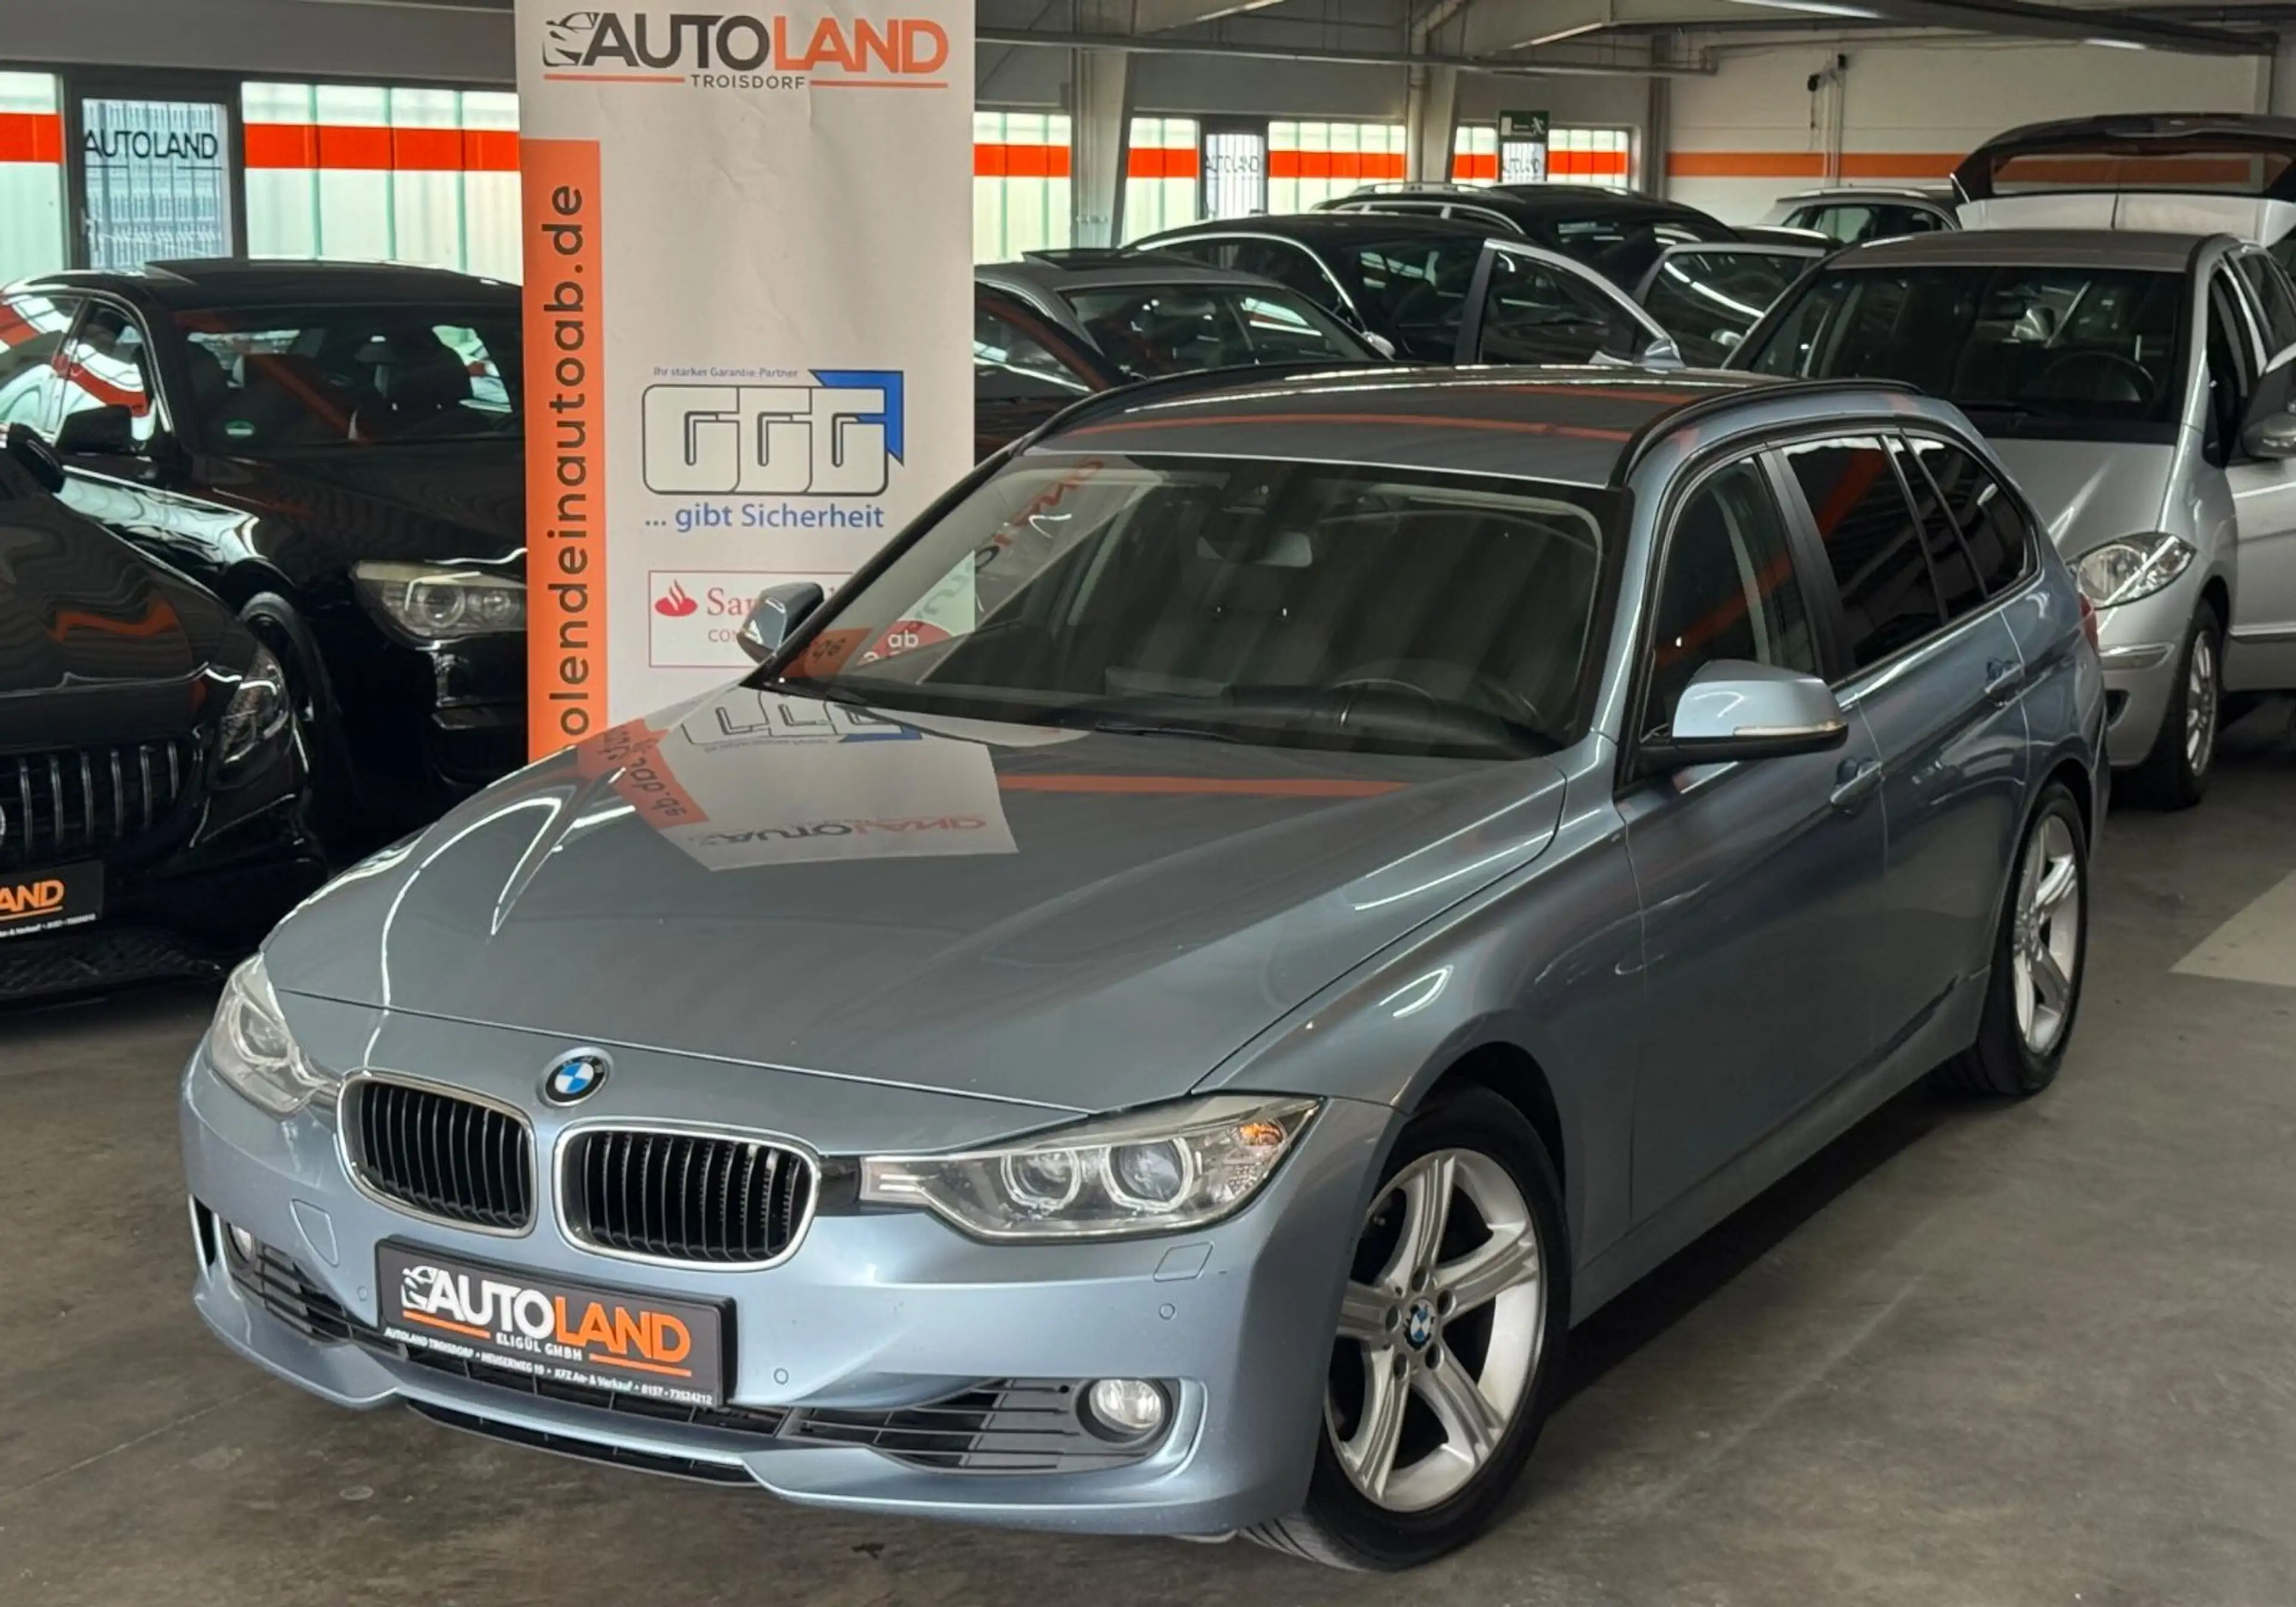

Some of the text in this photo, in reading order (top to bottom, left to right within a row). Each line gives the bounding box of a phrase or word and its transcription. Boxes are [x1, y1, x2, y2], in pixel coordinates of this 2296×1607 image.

[581, 12, 949, 75] AUTOLAND
[691, 74, 805, 89] TROISDORF
[84, 129, 218, 159] AUTOLAND
[675, 503, 732, 533] gibt
[741, 503, 885, 528] Sicherheit
[887, 630, 919, 648] ab
[426, 1269, 692, 1362] AUTOLAND
[496, 1332, 583, 1361] ELIGÜL GMBH
